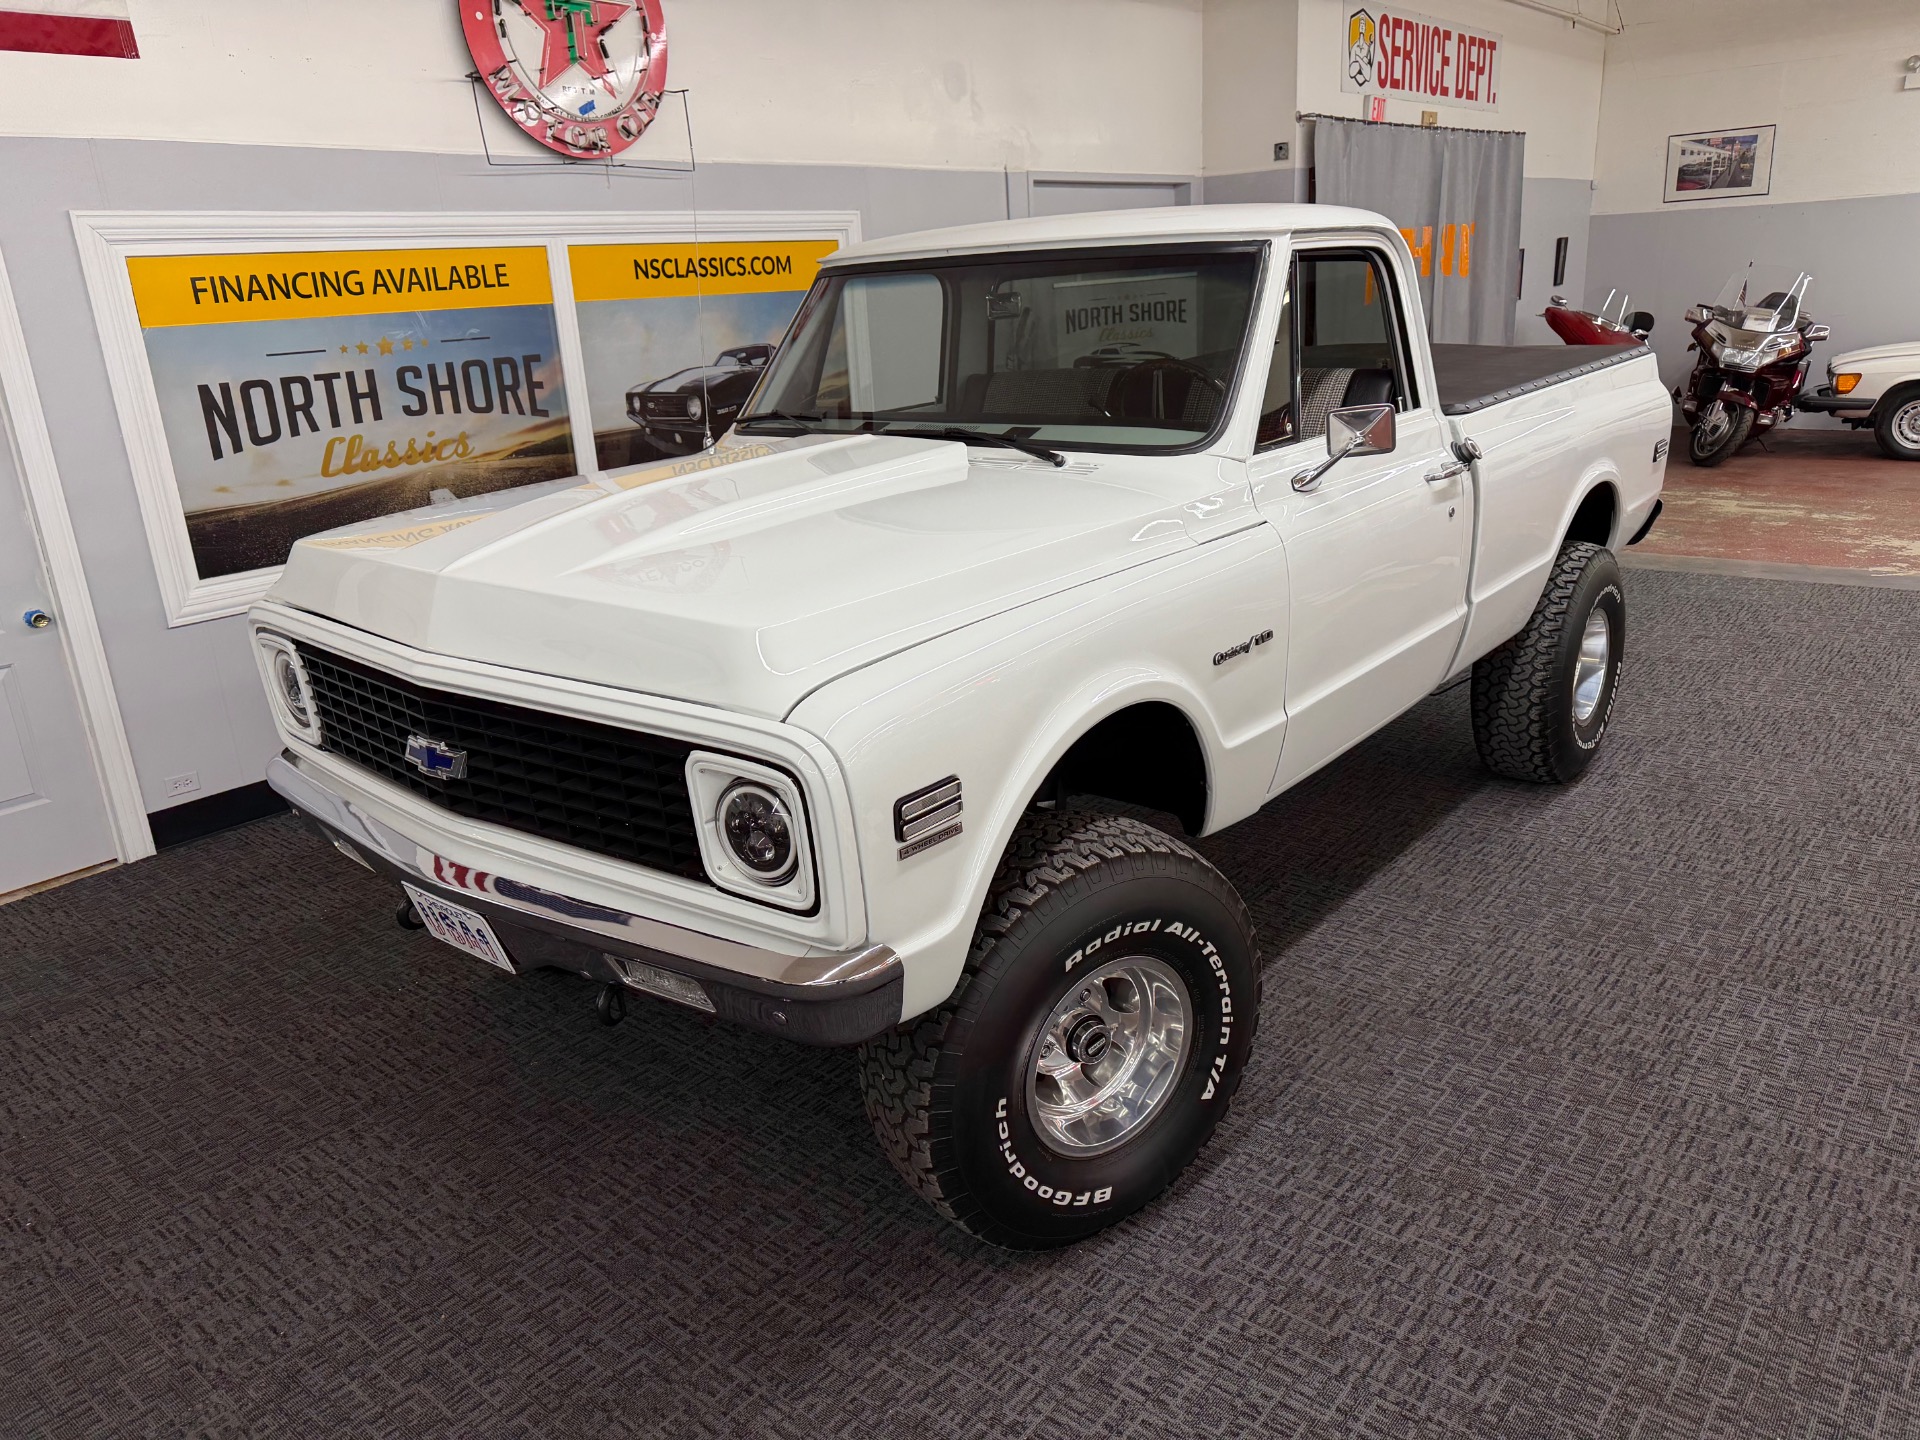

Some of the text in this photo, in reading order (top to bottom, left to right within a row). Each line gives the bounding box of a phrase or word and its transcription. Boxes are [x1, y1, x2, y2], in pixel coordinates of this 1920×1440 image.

[1377, 13, 1498, 105] SERVICE DEPT.
[488, 64, 613, 154] MOTOR
[190, 263, 510, 305] FINANCING AVAILABLE
[633, 255, 793, 280] NSCLASSICS.COM
[1065, 298, 1188, 334] NORTH SHORE
[197, 353, 550, 461] NORTH SHORE
[320, 429, 476, 479] Classics
[911, 837, 937, 852] WHEEL
[938, 826, 959, 840] DRIVE
[1063, 918, 1163, 972] Radial
[1163, 920, 1235, 1047] All-Terrain
[1200, 1055, 1233, 1101] T/A
[994, 1096, 1113, 1207] BFGoodrich
